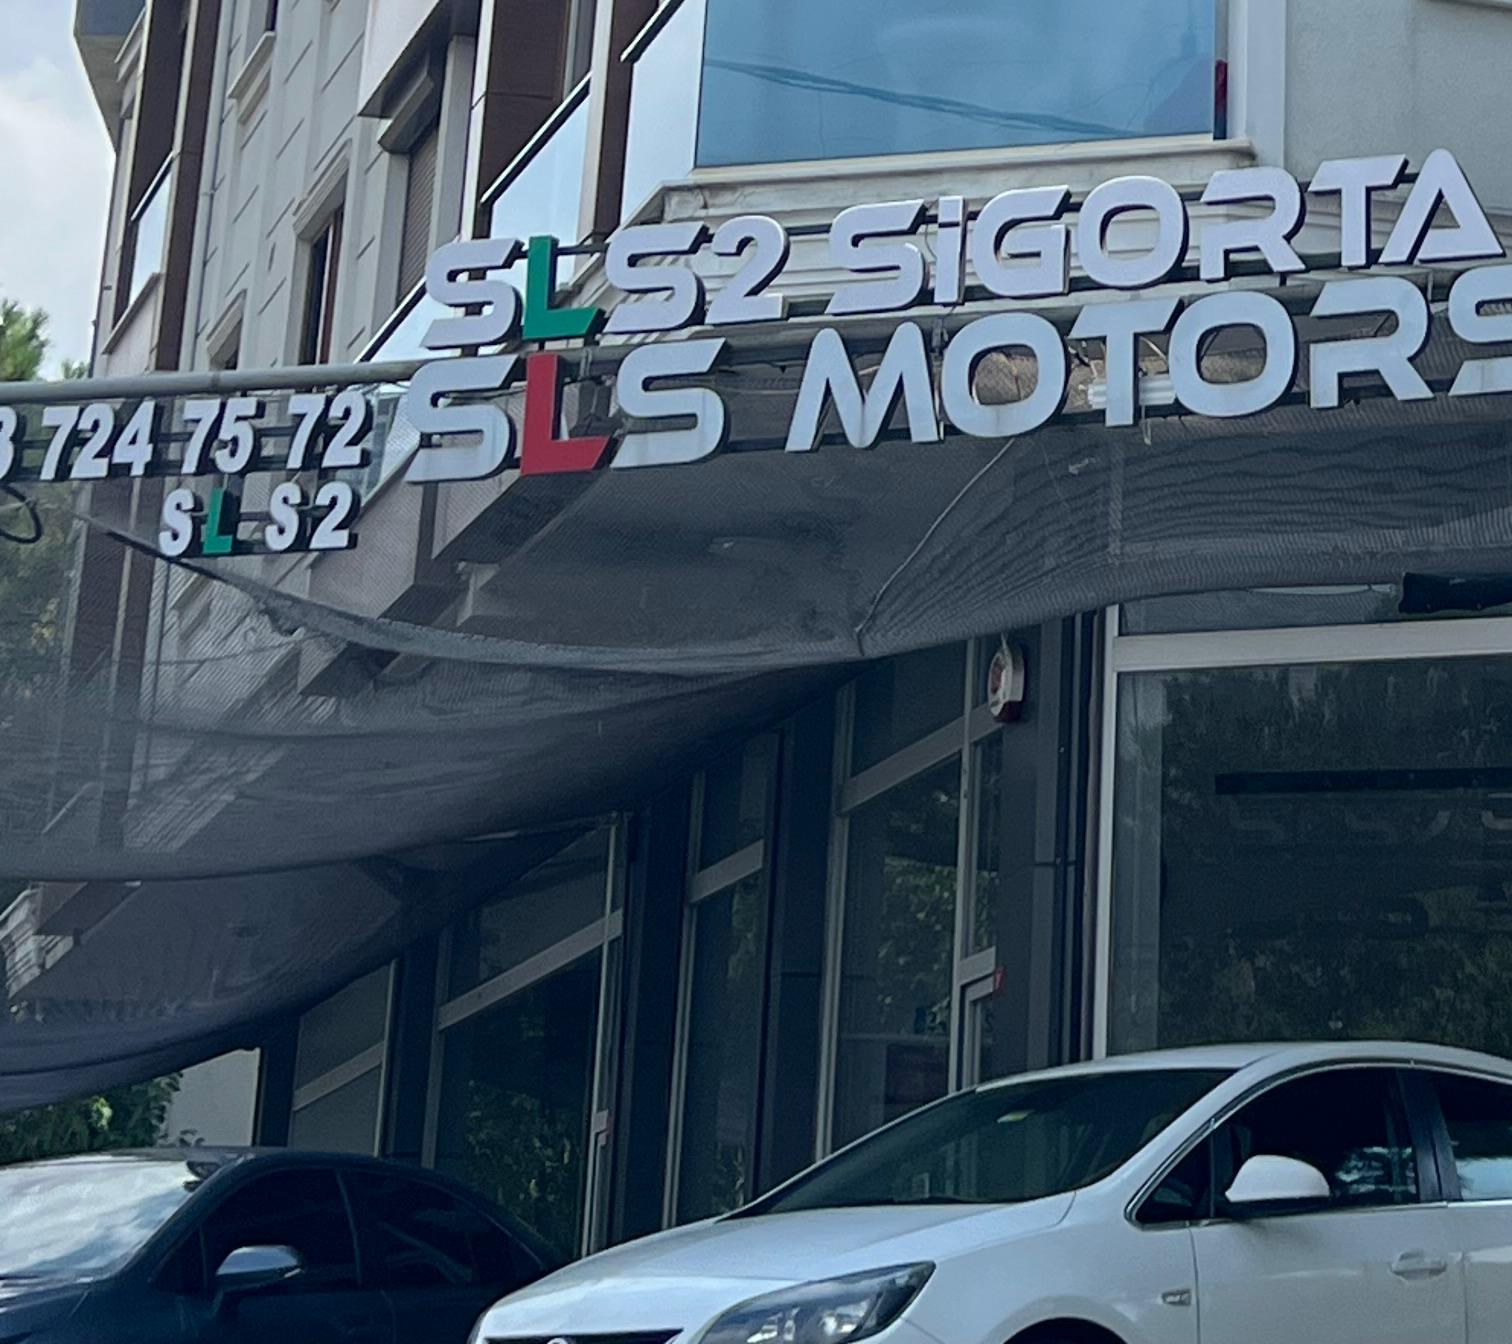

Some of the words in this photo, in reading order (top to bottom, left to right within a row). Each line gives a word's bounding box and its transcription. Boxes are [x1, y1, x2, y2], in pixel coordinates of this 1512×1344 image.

[419, 215, 789, 349] SLS2
[39, 400, 157, 481] 724
[181, 396, 259, 474] 75
[286, 391, 367, 470] 72
[402, 337, 726, 484] SLS
